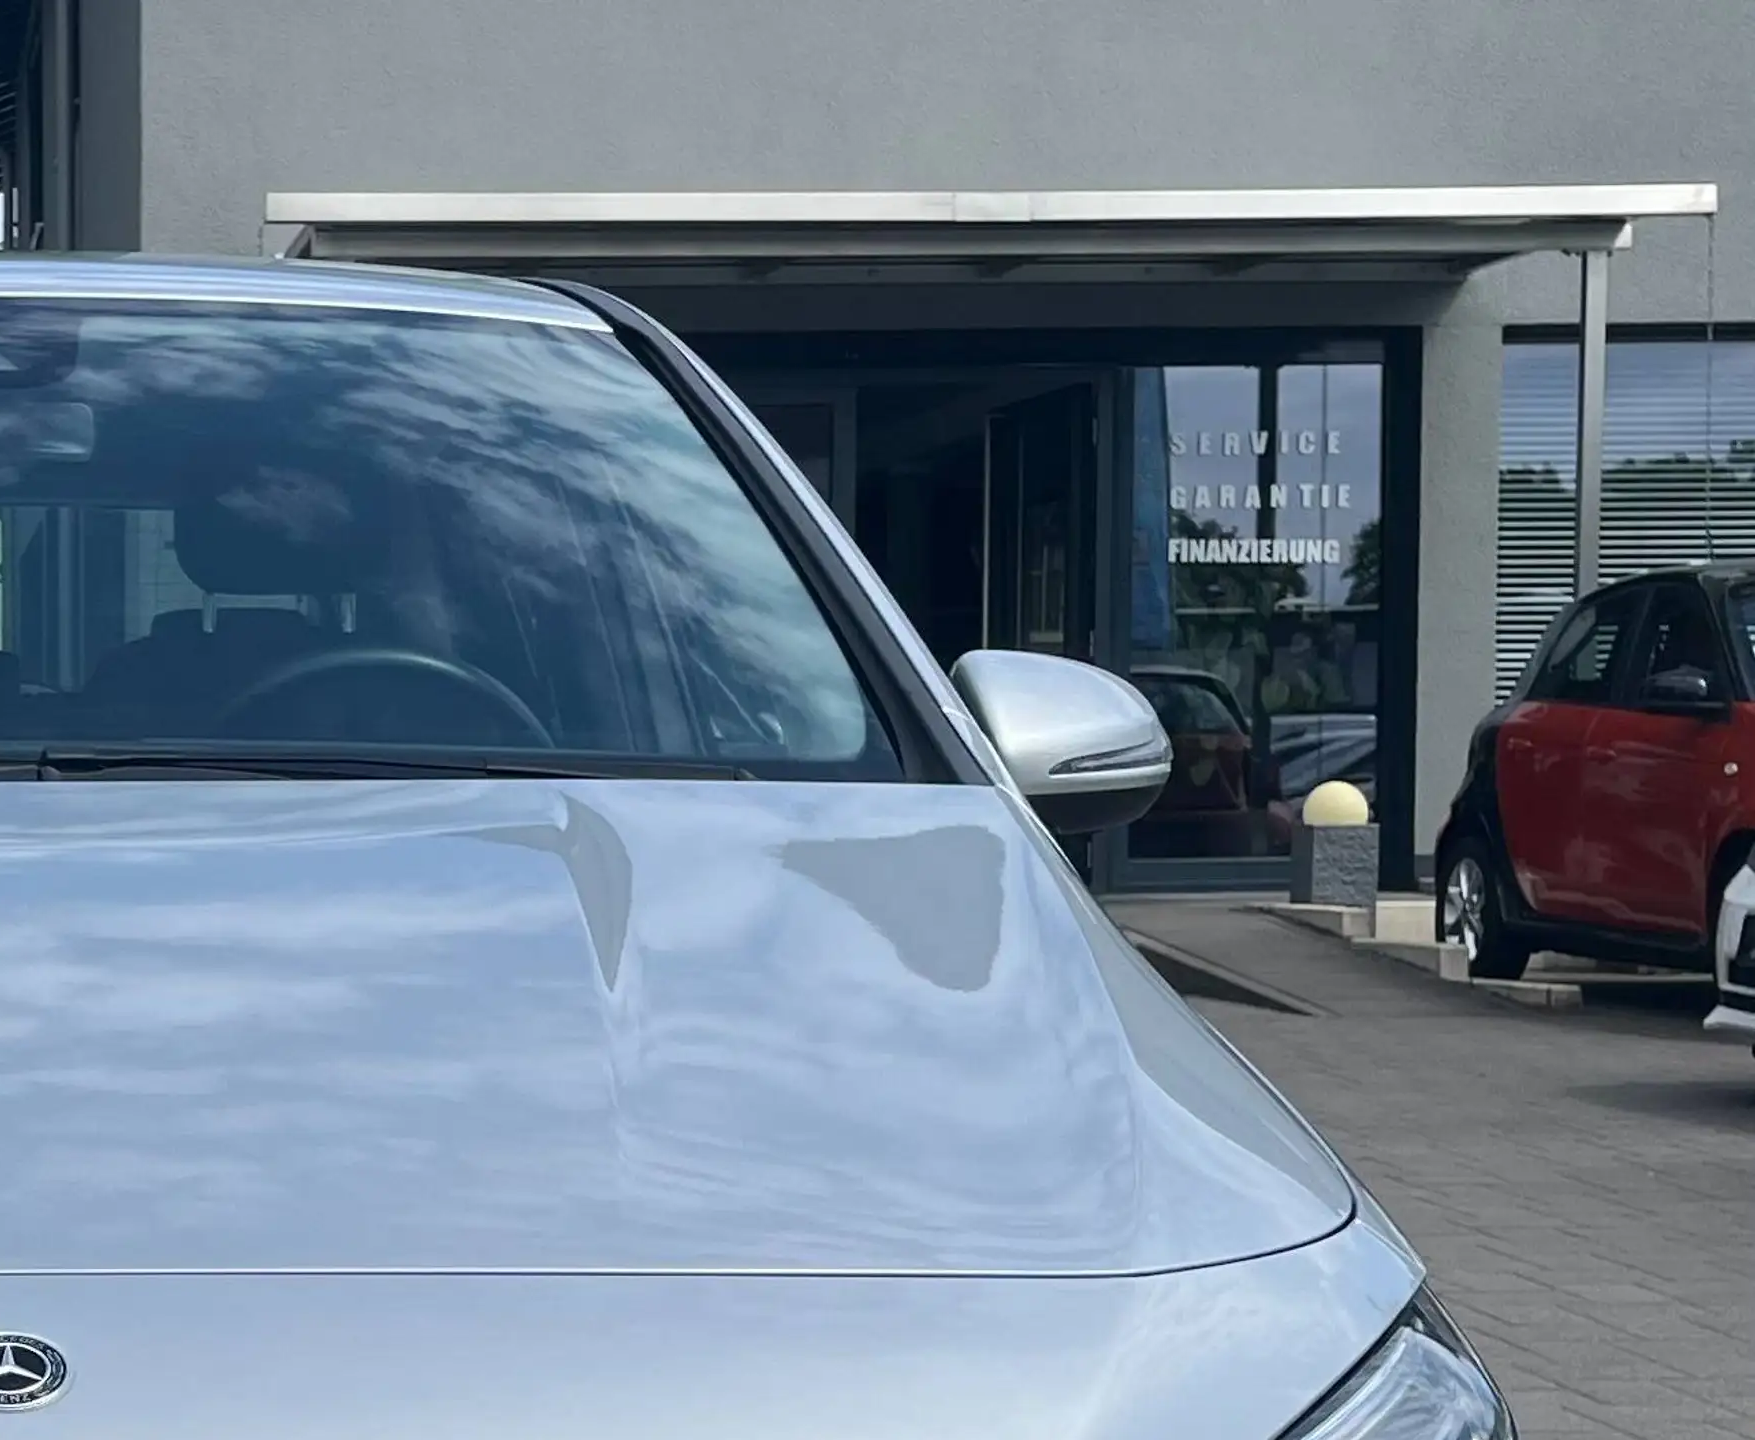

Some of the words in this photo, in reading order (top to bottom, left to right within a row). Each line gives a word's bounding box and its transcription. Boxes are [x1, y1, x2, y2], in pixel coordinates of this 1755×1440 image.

[1169, 430, 1341, 456] SERVICE
[1169, 483, 1352, 509] GARANTIE
[1167, 537, 1341, 564] FINANZIERUNG
